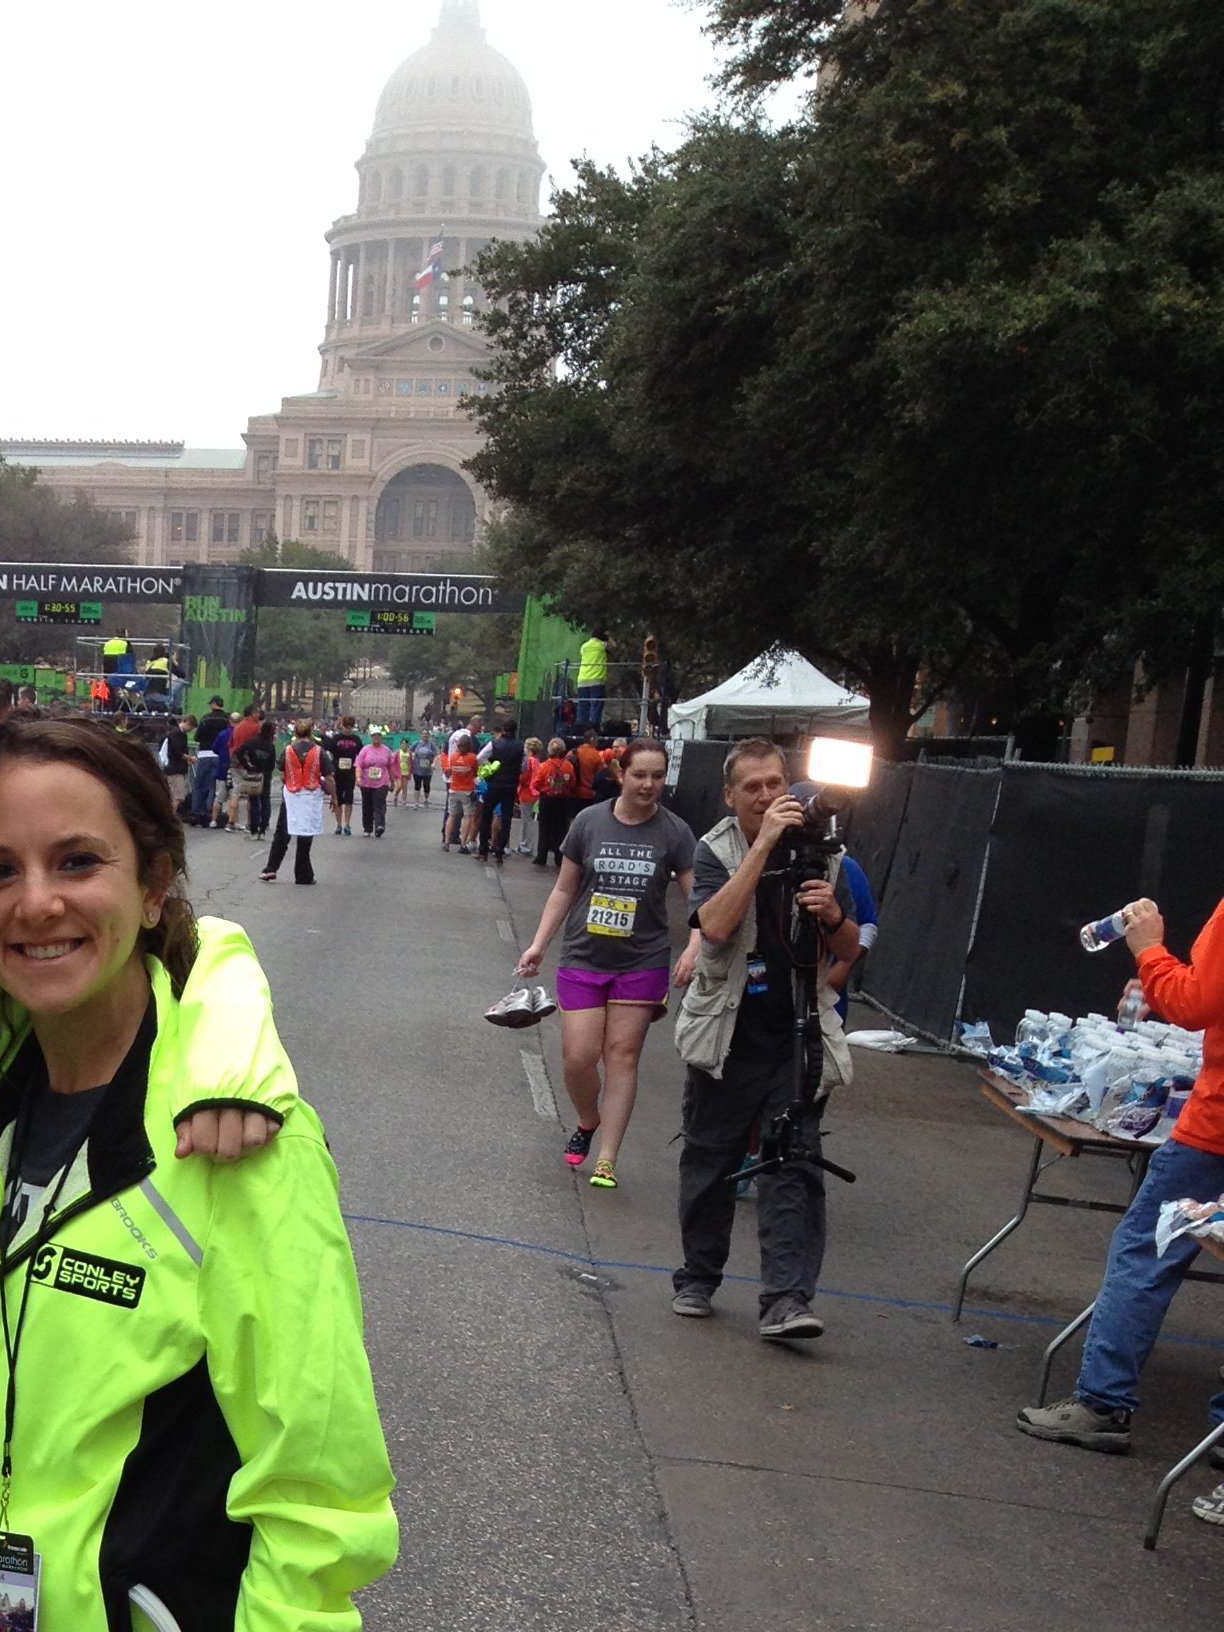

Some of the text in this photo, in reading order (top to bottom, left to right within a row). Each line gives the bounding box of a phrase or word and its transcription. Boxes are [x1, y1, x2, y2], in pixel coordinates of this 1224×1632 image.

[13, 574, 57, 591] HALF
[290, 578, 493, 606] AUSTINmarathon
[184, 595, 221, 609] RUN
[185, 608, 246, 623] AUSTIN
[599, 847, 653, 859] ALL THE
[598, 861, 651, 872] ROAD'S
[610, 875, 648, 886] STAGE
[591, 909, 629, 927] 21215
[109, 1197, 158, 1260] BROOKS
[60, 1257, 141, 1287] CONLEY
[58, 1270, 137, 1300] SPORTS
